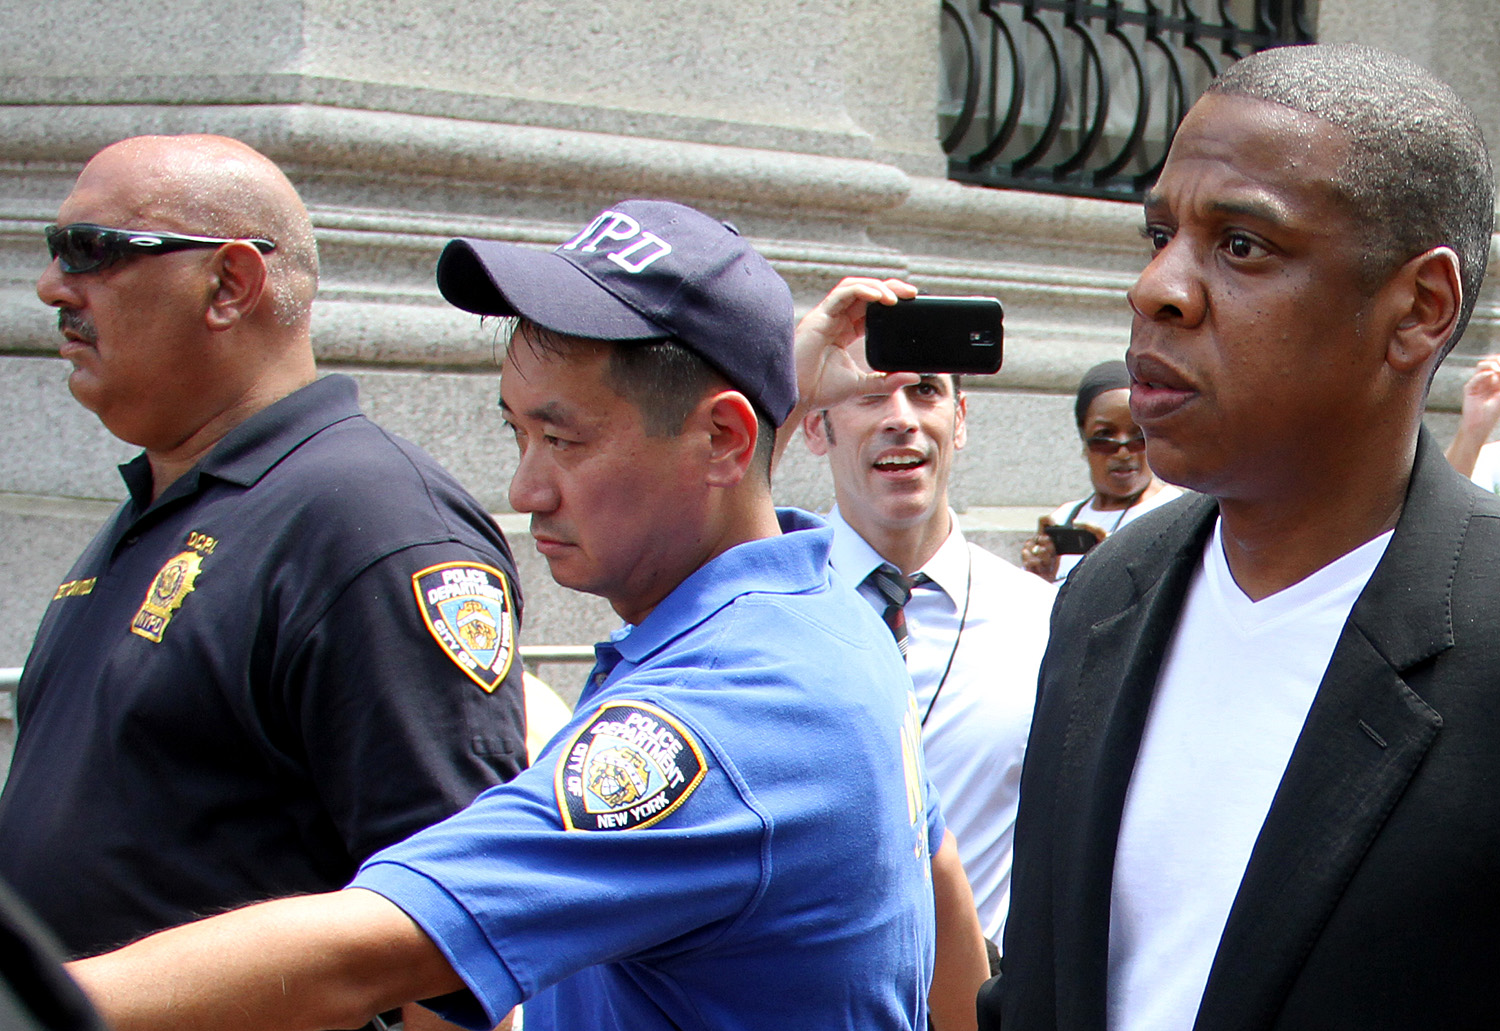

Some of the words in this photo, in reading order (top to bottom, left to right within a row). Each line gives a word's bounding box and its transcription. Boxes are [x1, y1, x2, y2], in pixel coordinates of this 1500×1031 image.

[563, 210, 672, 274] YPD
[441, 568, 489, 585] POLICE
[135, 611, 163, 633] NYPD
[433, 619, 460, 650] CITY
[624, 712, 684, 759] POLICE
[569, 742, 589, 774] CITY
[590, 721, 685, 790] DEPARTMENT
[566, 776, 583, 798] OF
[597, 811, 629, 829] NEW
[630, 791, 670, 822] YORK
